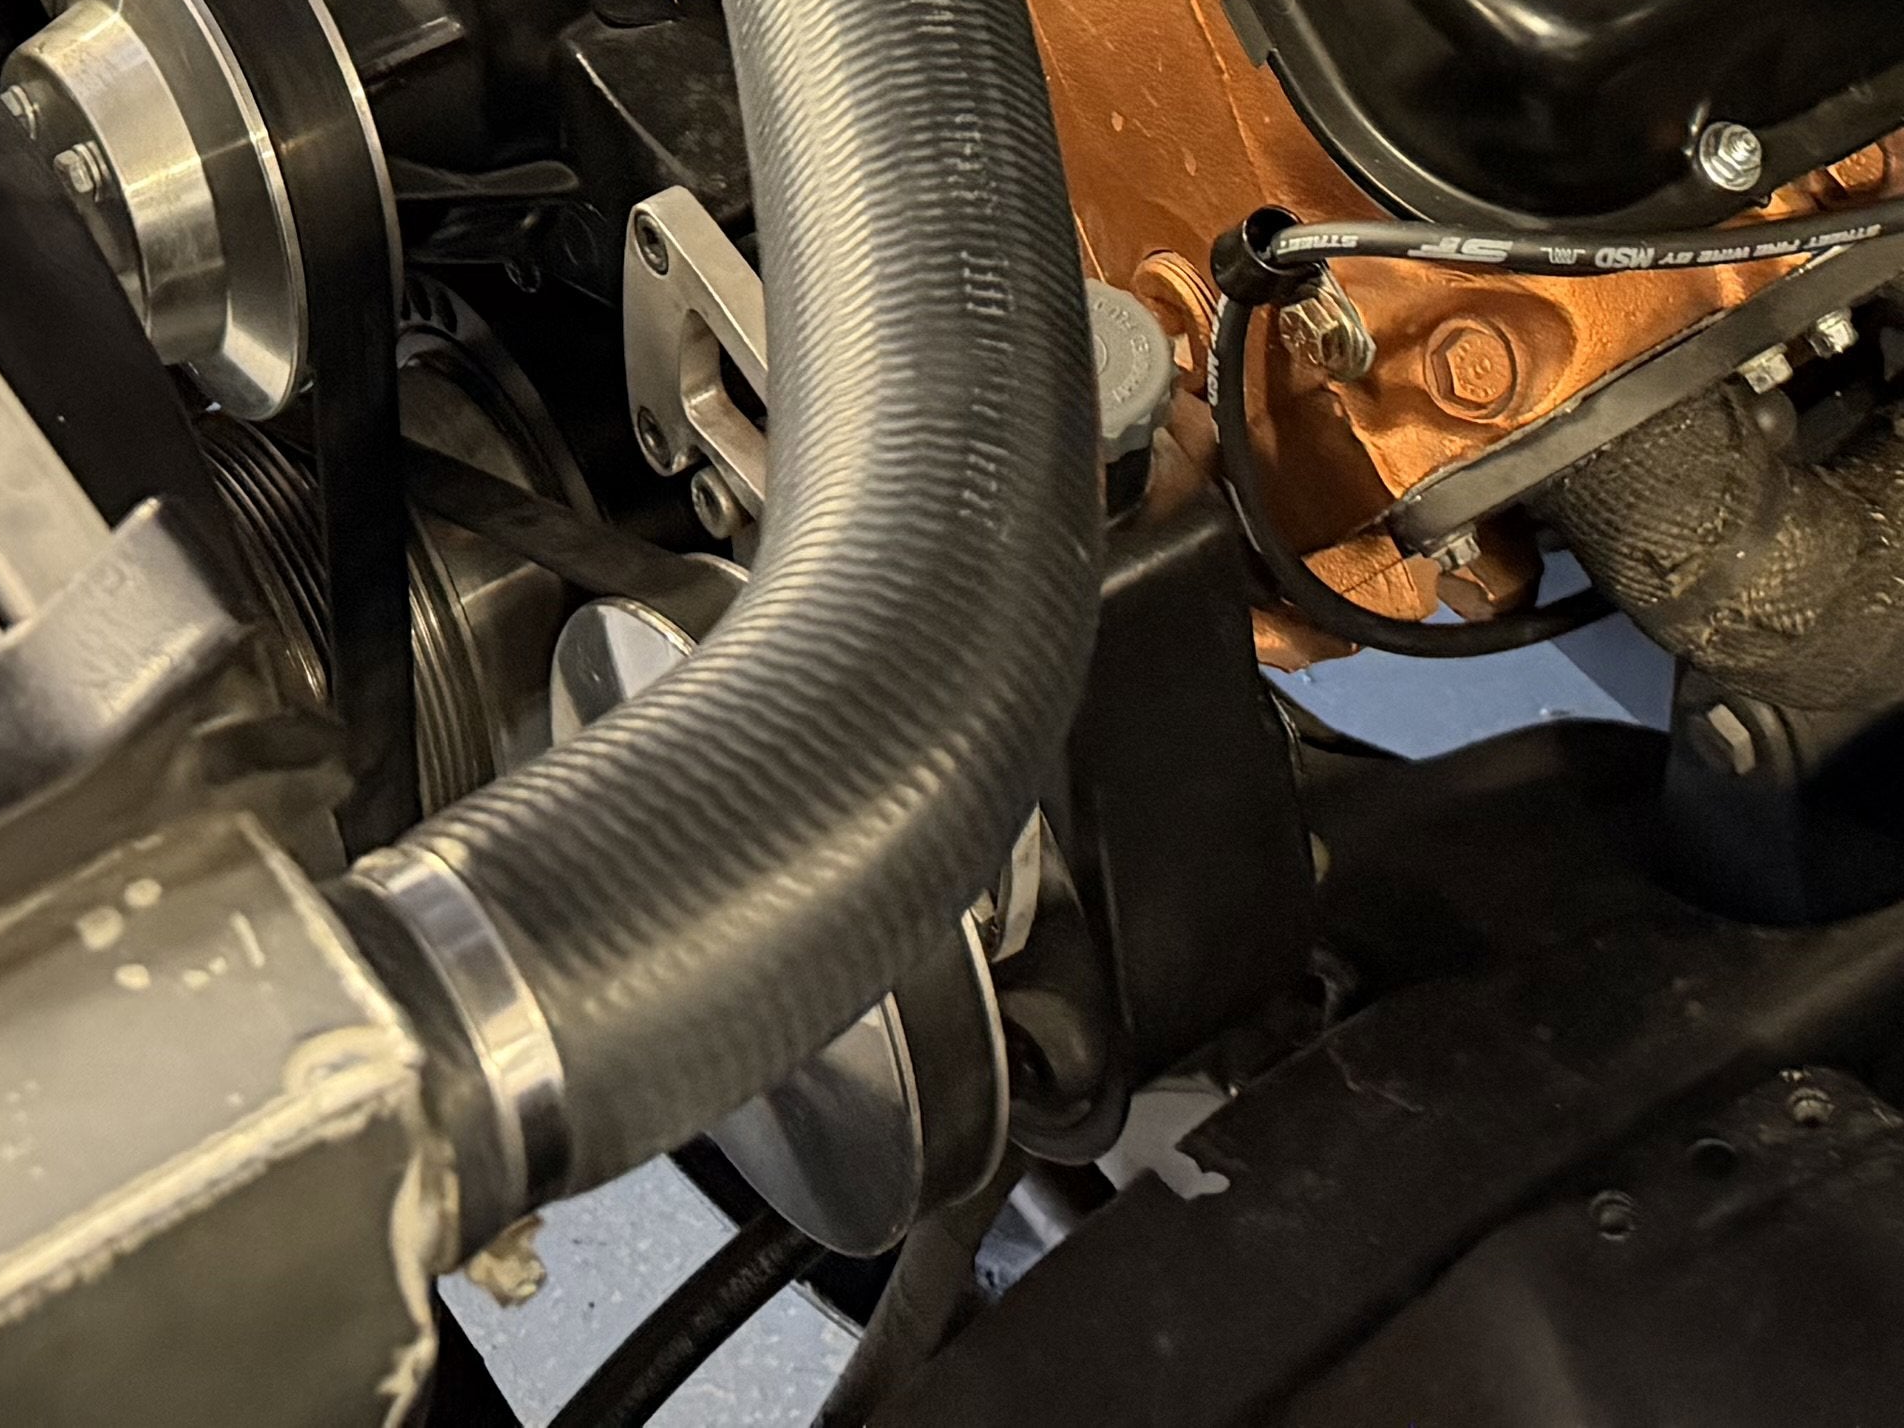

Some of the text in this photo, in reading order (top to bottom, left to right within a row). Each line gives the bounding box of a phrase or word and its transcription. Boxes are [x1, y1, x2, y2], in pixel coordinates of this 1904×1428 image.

[1802, 223, 1882, 250] STREET
[1697, 245, 1751, 263] WIRE
[1752, 239, 1801, 256] FIRE
[1594, 246, 1657, 269] MSD
[1658, 251, 1695, 265] BY
